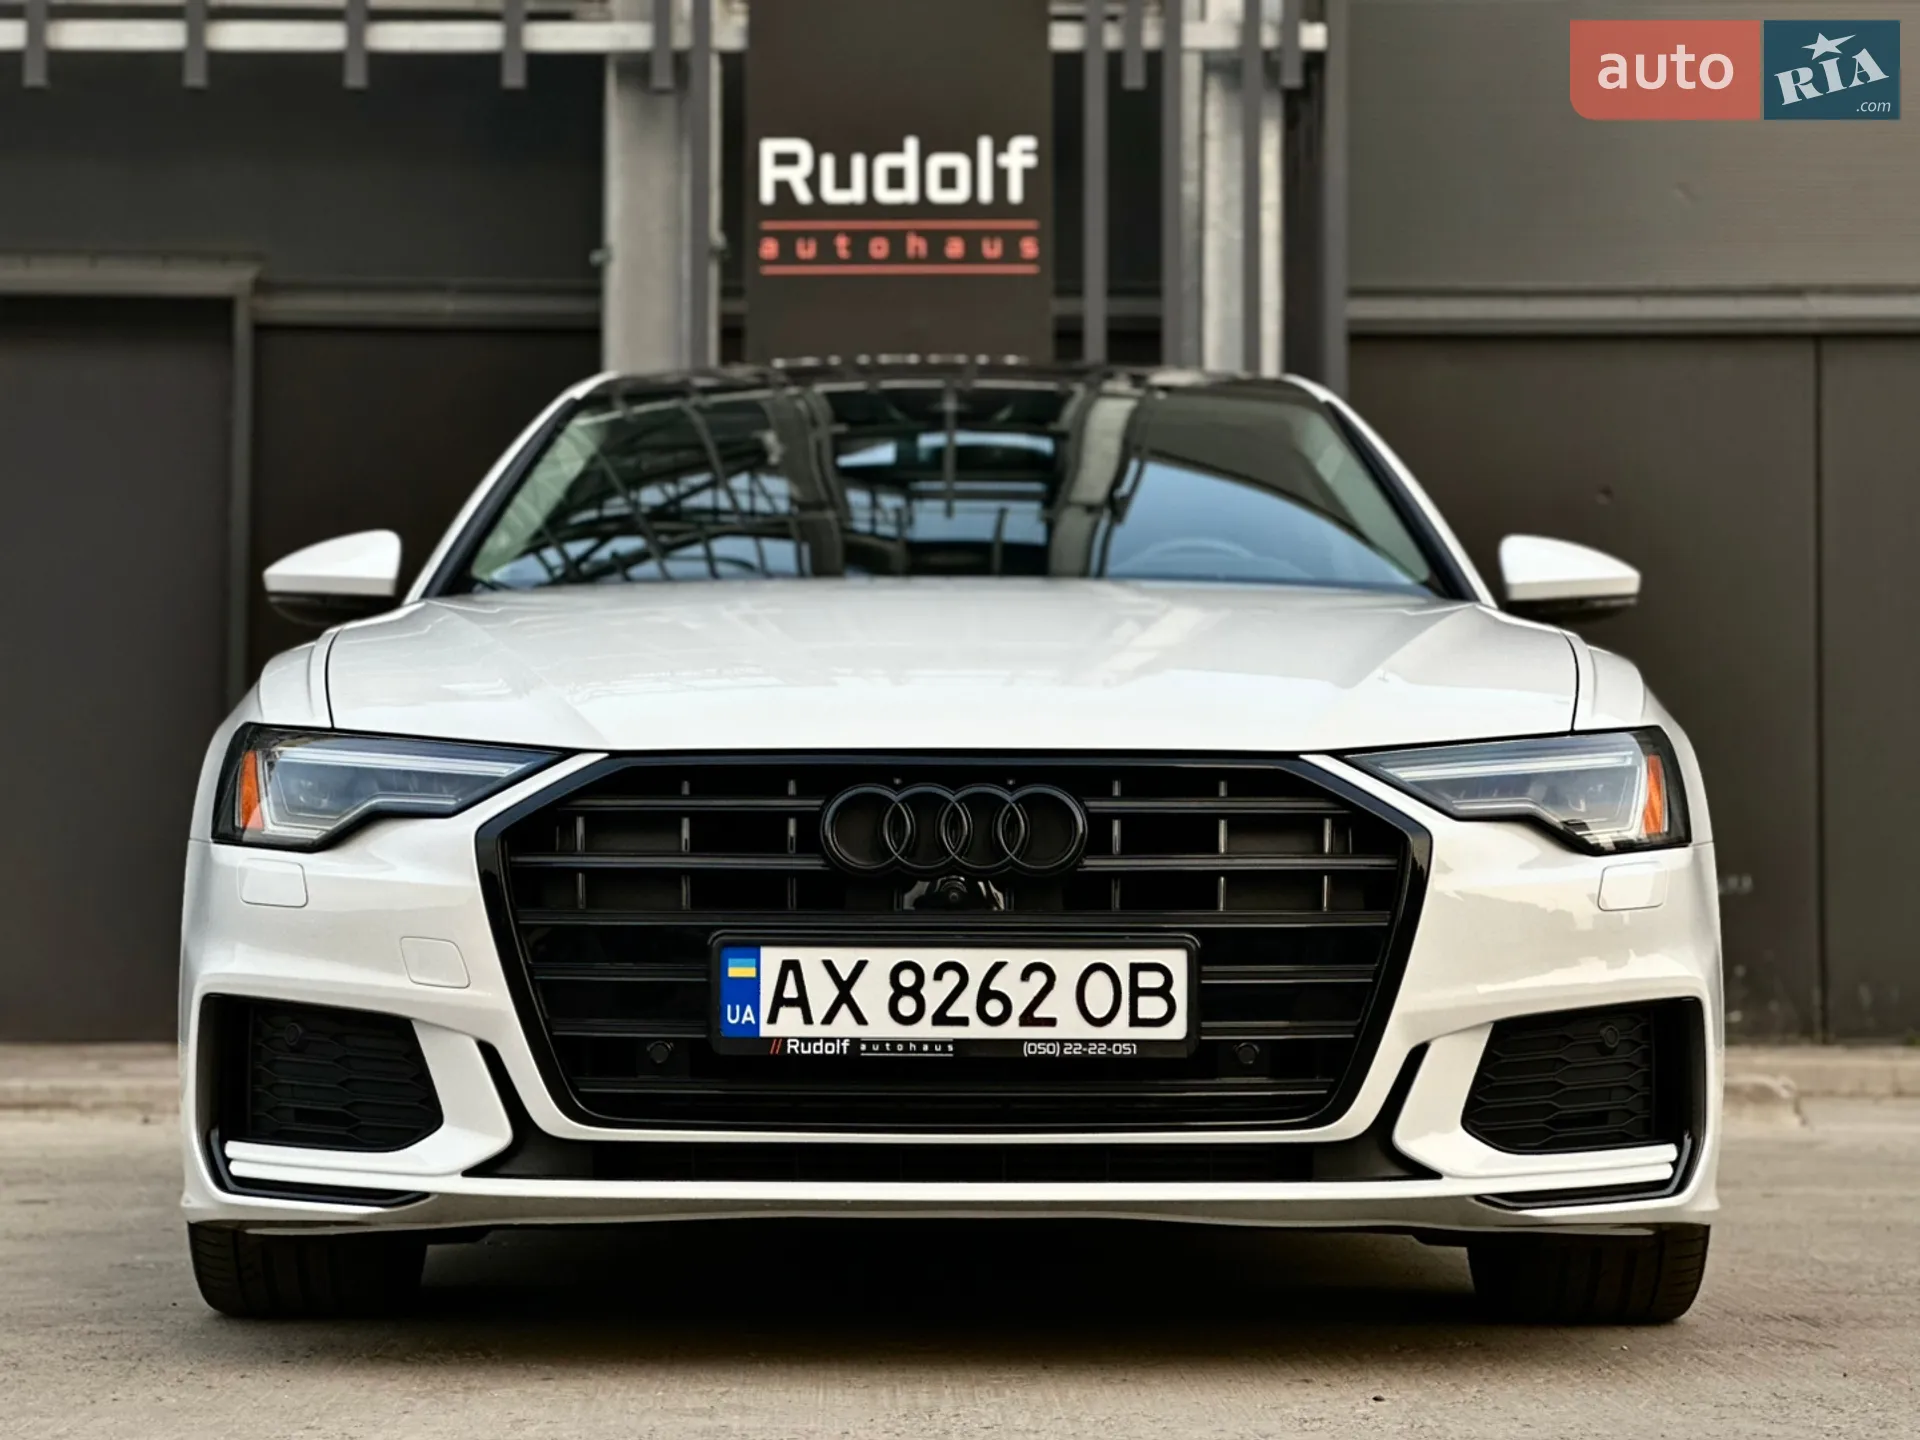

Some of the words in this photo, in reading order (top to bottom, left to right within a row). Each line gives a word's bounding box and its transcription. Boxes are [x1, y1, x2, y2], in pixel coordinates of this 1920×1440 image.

[758, 135, 1039, 205] Rudolf
[758, 231, 1040, 260] autohaus
[766, 959, 869, 1025] AX
[888, 961, 1057, 1027] 8262
[1075, 962, 1177, 1027] OB
[727, 1004, 755, 1025] UA
[786, 1038, 850, 1055] Rudolf
[859, 1042, 954, 1052] autohaus
[1023, 1041, 1060, 1057] (050)
[1063, 1042, 1138, 1055] 22-22-051
